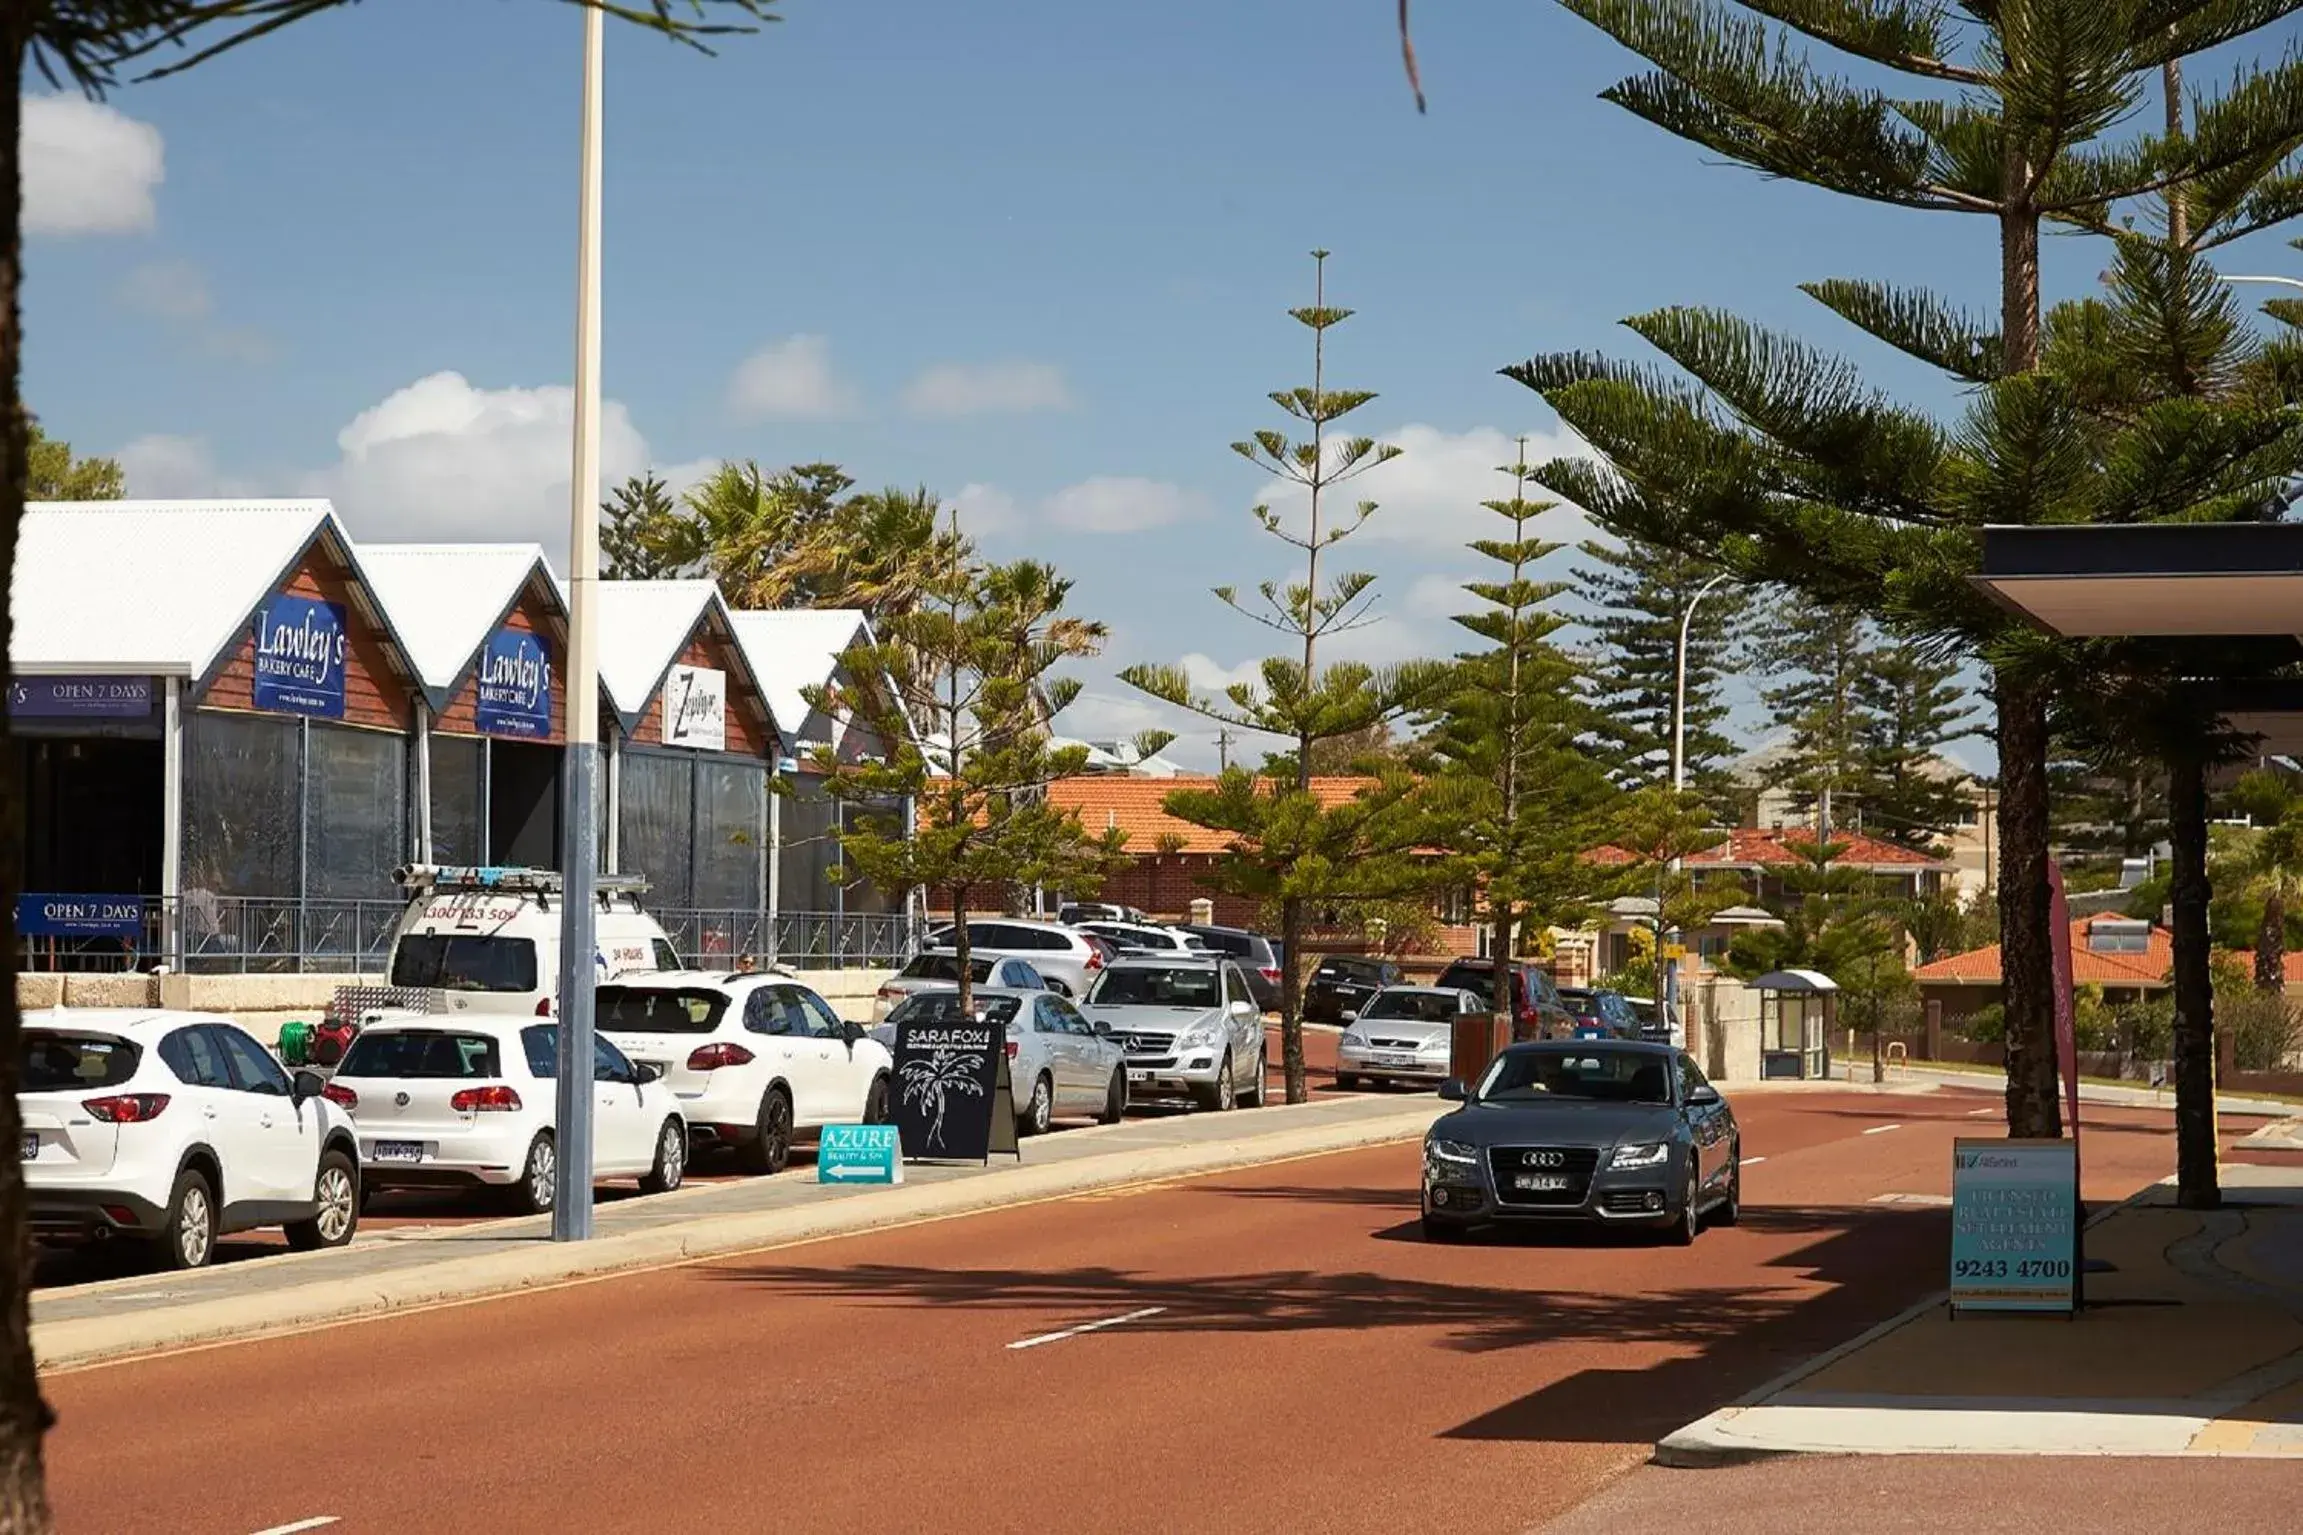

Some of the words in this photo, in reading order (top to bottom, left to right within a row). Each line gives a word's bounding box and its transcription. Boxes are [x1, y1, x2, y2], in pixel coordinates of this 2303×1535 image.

[258, 607, 344, 684] Lawley's
[258, 657, 292, 676] BAKERY
[481, 640, 551, 709] Lawley's
[52, 683, 93, 698] OPEN
[98, 684, 105, 698] 7
[110, 684, 147, 698] DAYS
[480, 685, 508, 703] BAKERY
[43, 903, 84, 918] OPEN
[89, 904, 97, 917] 7
[102, 905, 138, 919] DAYS
[823, 1129, 894, 1148] AZURE
[827, 1150, 859, 1161] BEAUTY
[1955, 1260, 2008, 1278] 9243
[2016, 1260, 2070, 1278] 4700
